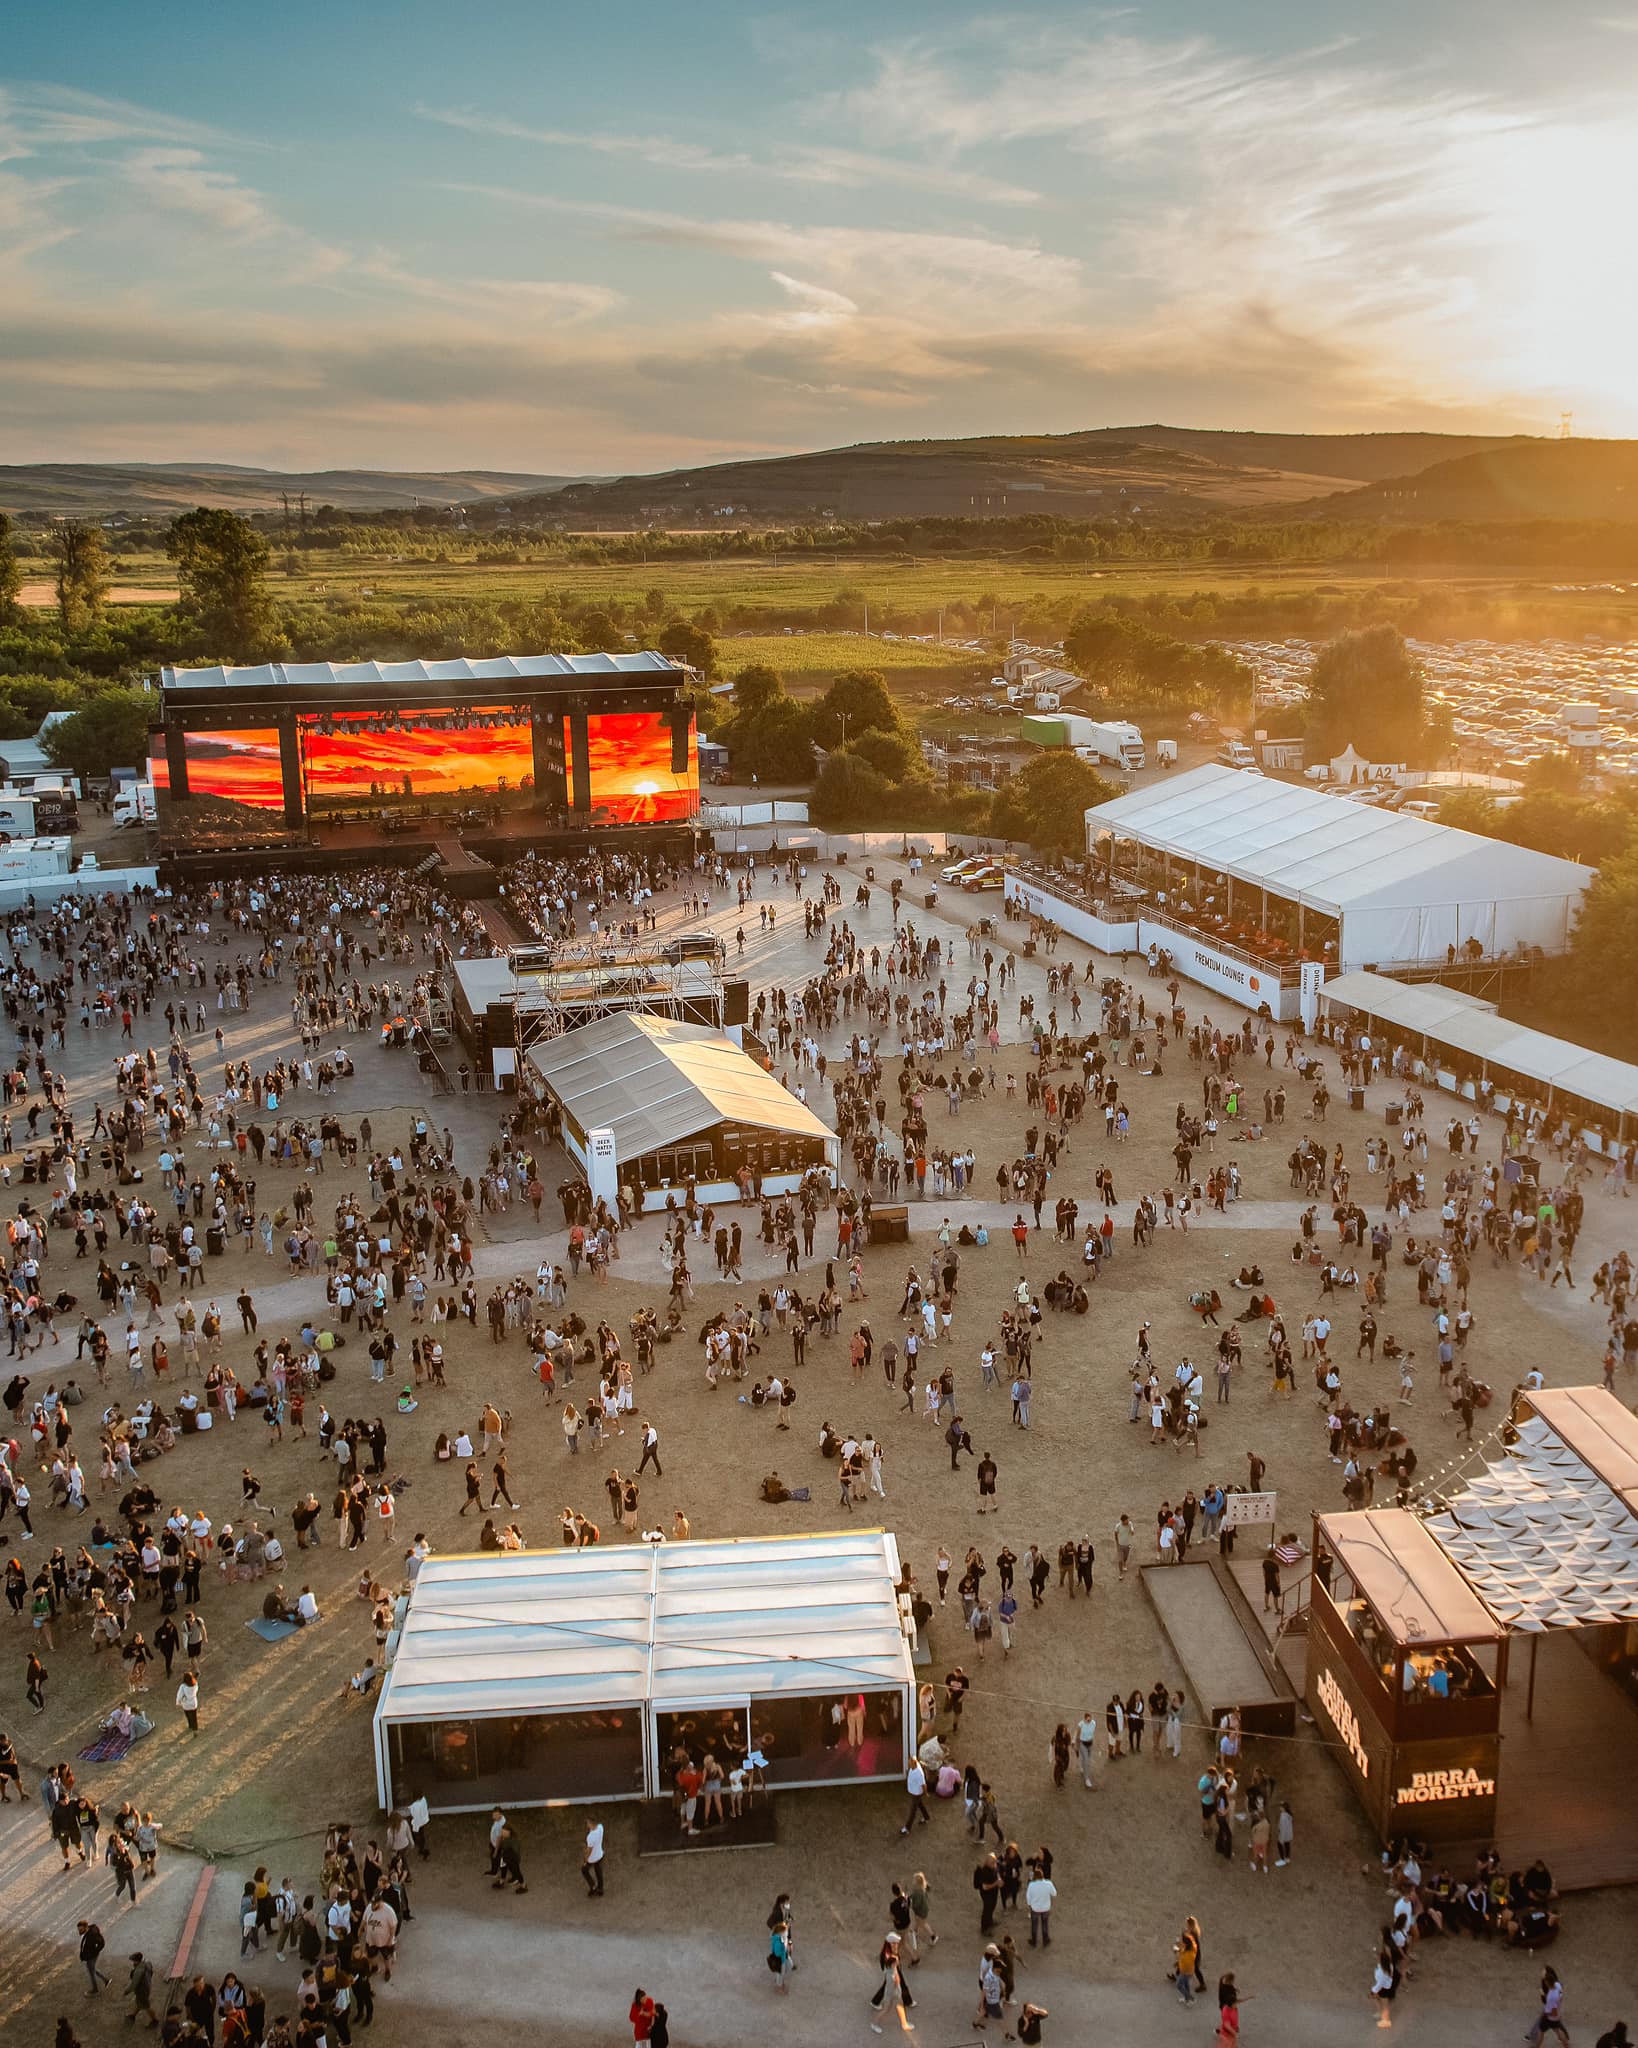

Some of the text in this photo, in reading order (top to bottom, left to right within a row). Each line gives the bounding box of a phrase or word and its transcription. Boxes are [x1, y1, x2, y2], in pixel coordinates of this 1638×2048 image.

[1376, 767, 1392, 779] A2
[38, 803, 61, 815] OB18
[1195, 951, 1245, 985] PREMIUM LOUNGE
[1325, 1668, 1361, 1748] BIRRA
[1317, 1674, 1368, 1778] MORETTI
[1412, 1767, 1480, 1788] BIRRA
[1397, 1779, 1495, 1804] MORETTI
